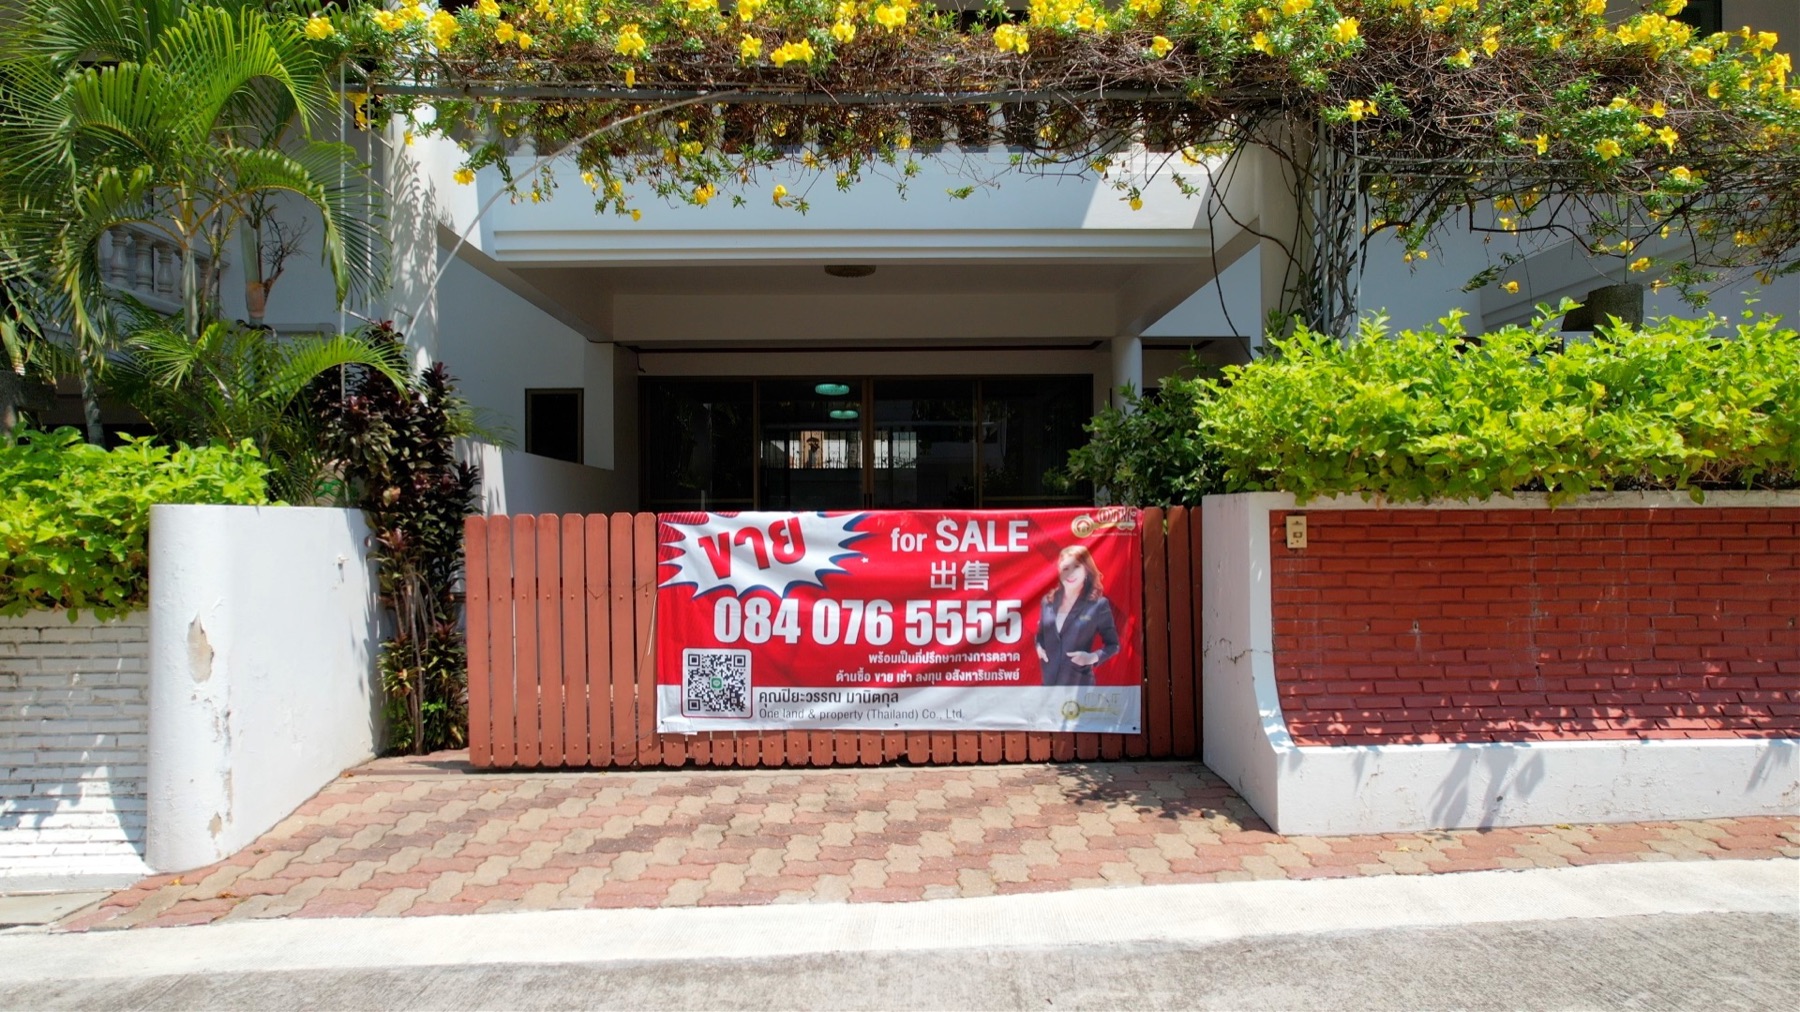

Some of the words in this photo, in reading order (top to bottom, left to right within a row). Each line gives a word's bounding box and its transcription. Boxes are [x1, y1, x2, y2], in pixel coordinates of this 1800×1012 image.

[698, 516, 806, 580] ขาย
[890, 527, 928, 552] for
[936, 519, 1029, 553] SALE
[930, 560, 990, 591] 出售
[714, 596, 801, 644] 084
[812, 598, 893, 646] 076
[905, 599, 1022, 646] 5555
[874, 672, 894, 683] ขาย
[896, 670, 913, 682] เช่า
[915, 671, 942, 685] ลงทุน
[759, 688, 841, 708] คุณปิยะวรรณ
[759, 708, 780, 719] One
[783, 708, 804, 719] land
[808, 708, 816, 719] &
[819, 710, 863, 721] property
[866, 708, 919, 721] (Thailand)
